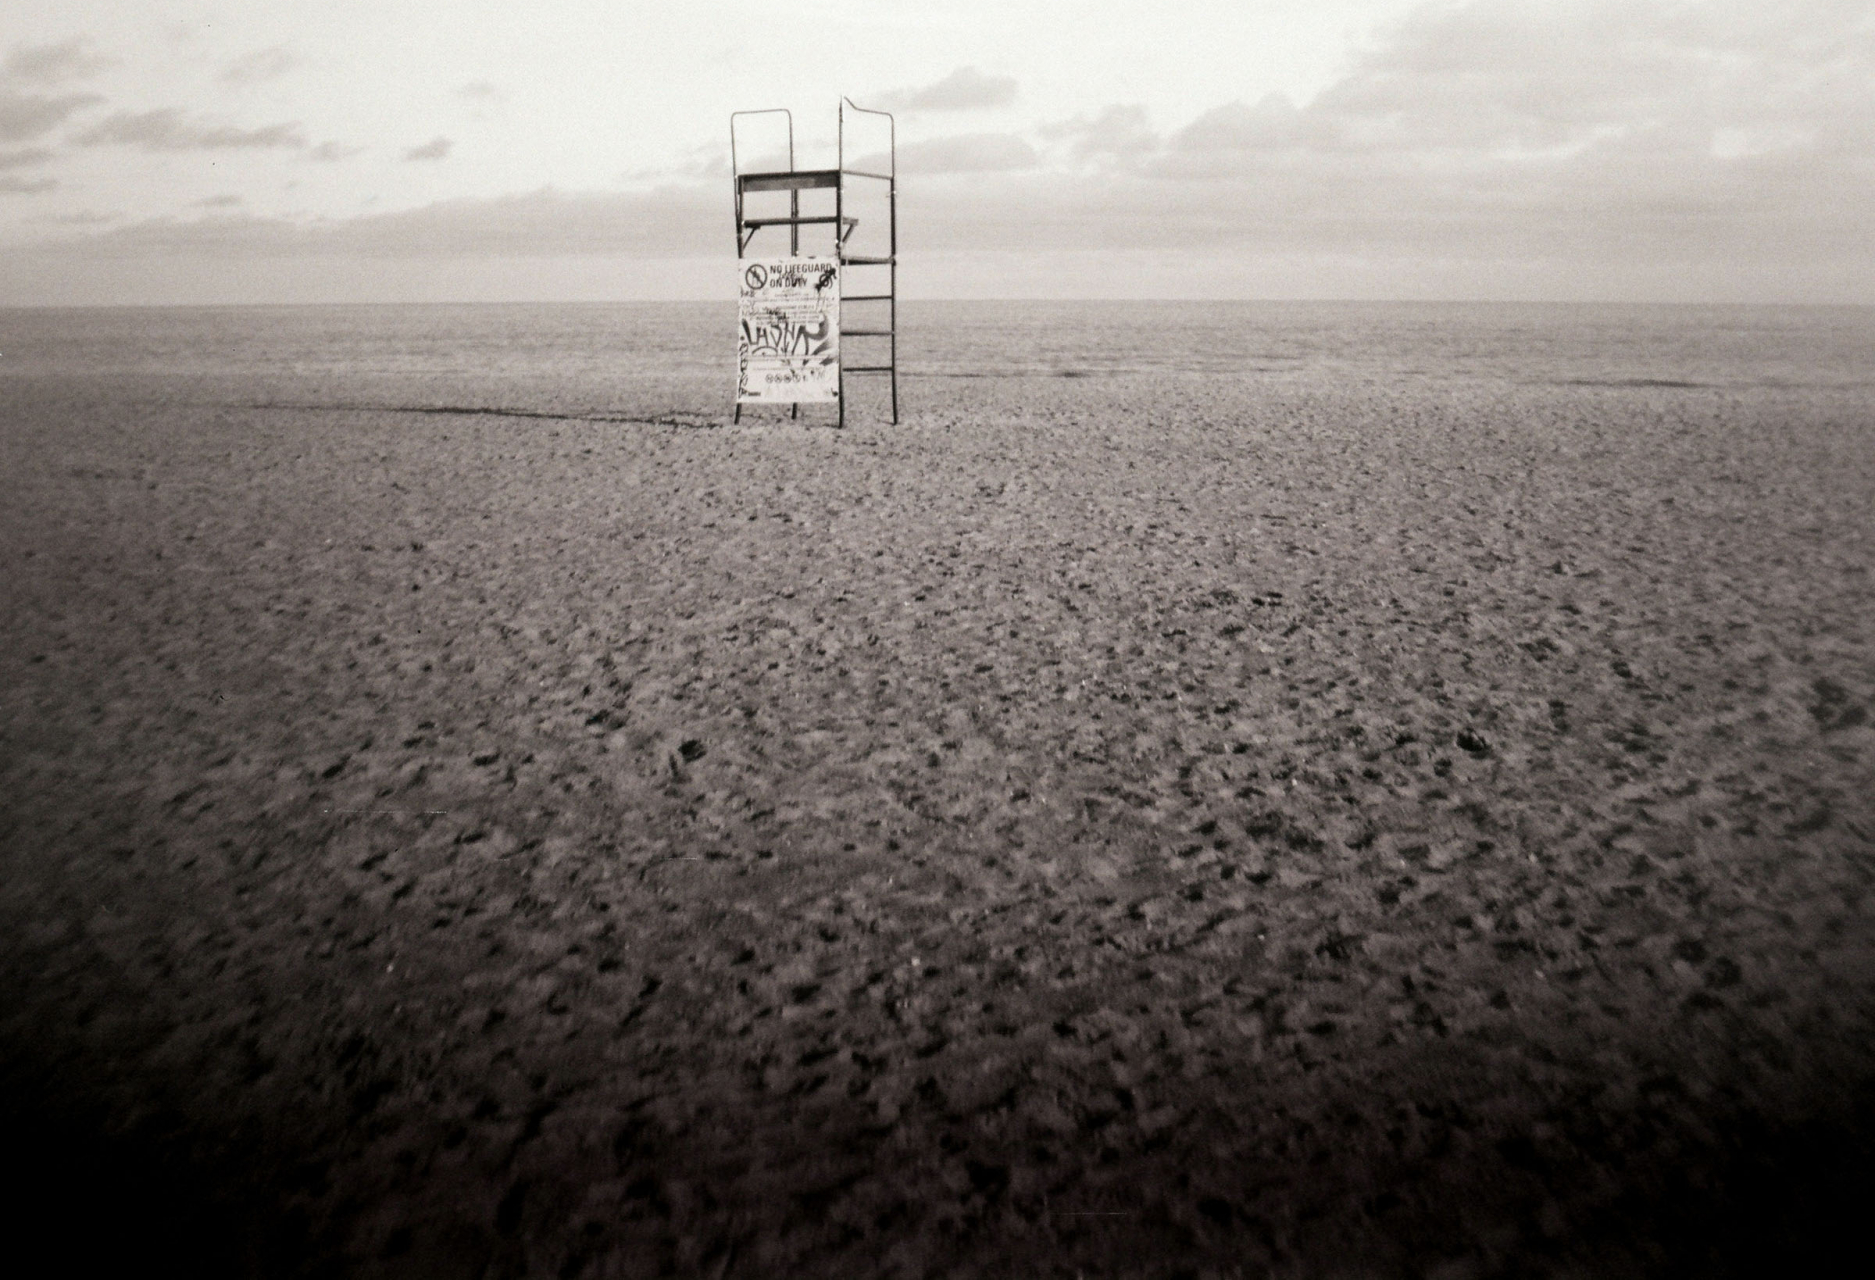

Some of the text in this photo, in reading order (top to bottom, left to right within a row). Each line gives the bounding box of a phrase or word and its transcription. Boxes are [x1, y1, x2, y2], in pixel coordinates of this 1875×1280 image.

[770, 263, 832, 274] NO LIFEGUARD
[770, 278, 807, 288] ON DUTY
